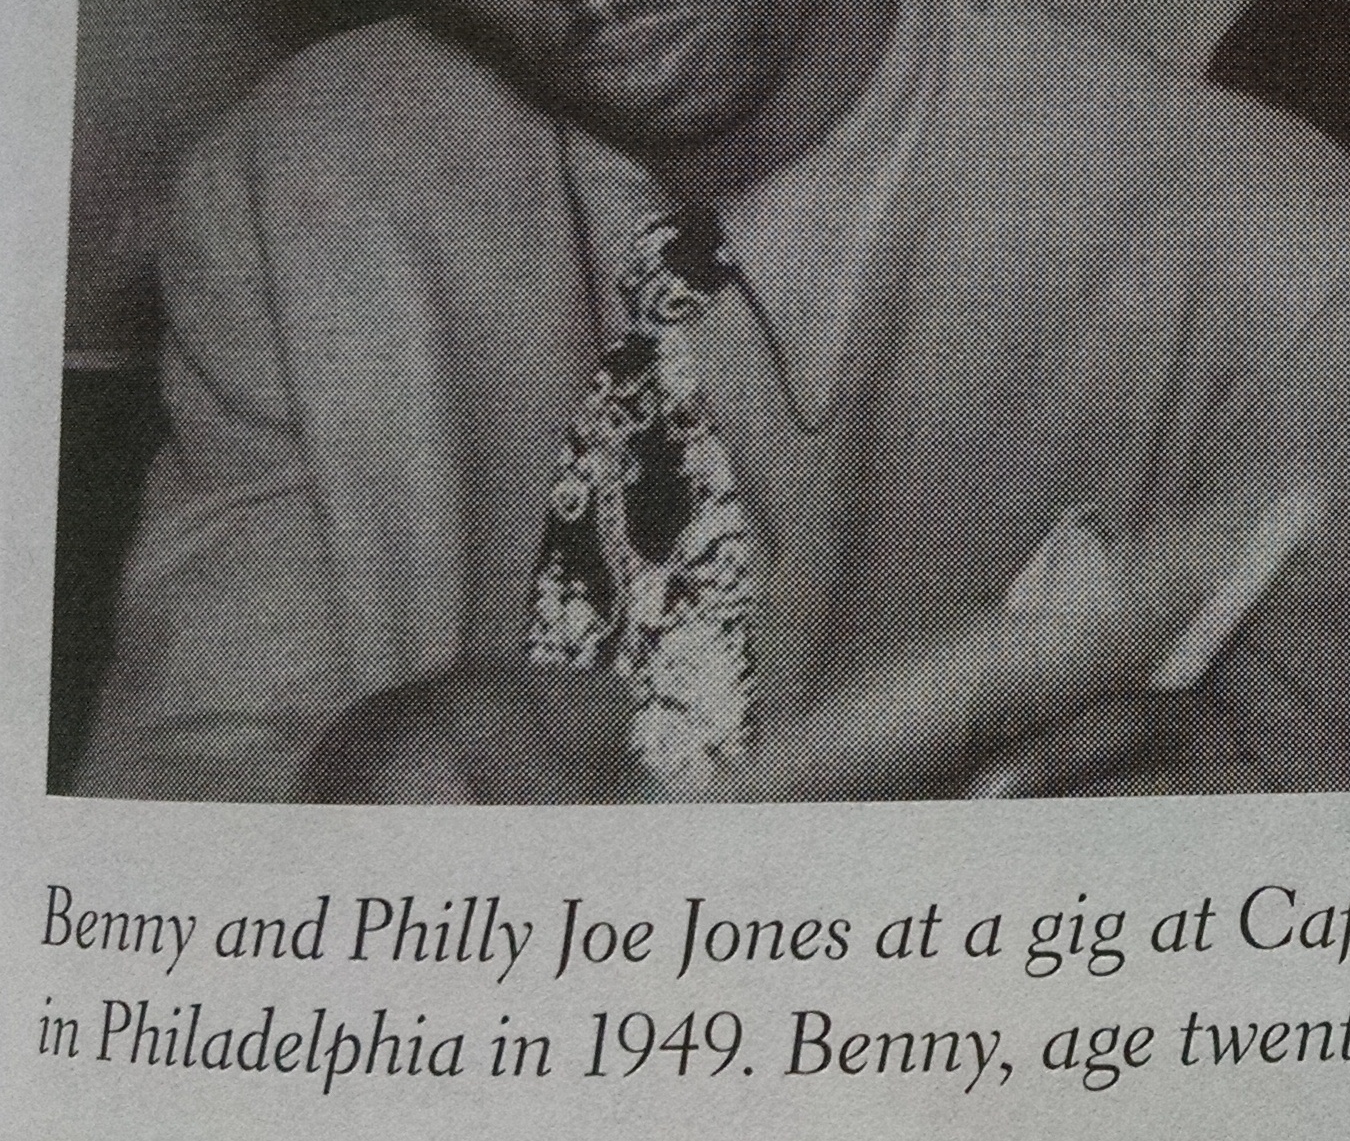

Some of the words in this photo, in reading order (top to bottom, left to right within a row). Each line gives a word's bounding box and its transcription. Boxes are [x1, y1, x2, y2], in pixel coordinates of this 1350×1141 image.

[39, 883, 198, 978] Benny
[214, 893, 332, 962] and
[346, 894, 535, 986] Philly
[552, 896, 656, 982] Joe
[675, 896, 853, 981] Jones
[874, 902, 945, 961] at
[962, 912, 1004, 959] a
[1023, 891, 1127, 980] gig
[1149, 895, 1218, 955] at
[37, 994, 81, 1060] in
[94, 998, 466, 1097] Philadelphia
[489, 1013, 553, 1079] in
[582, 1009, 755, 1079] 1949.
[782, 1008, 1015, 1096] Benny,
[1041, 1022, 1156, 1093] age
